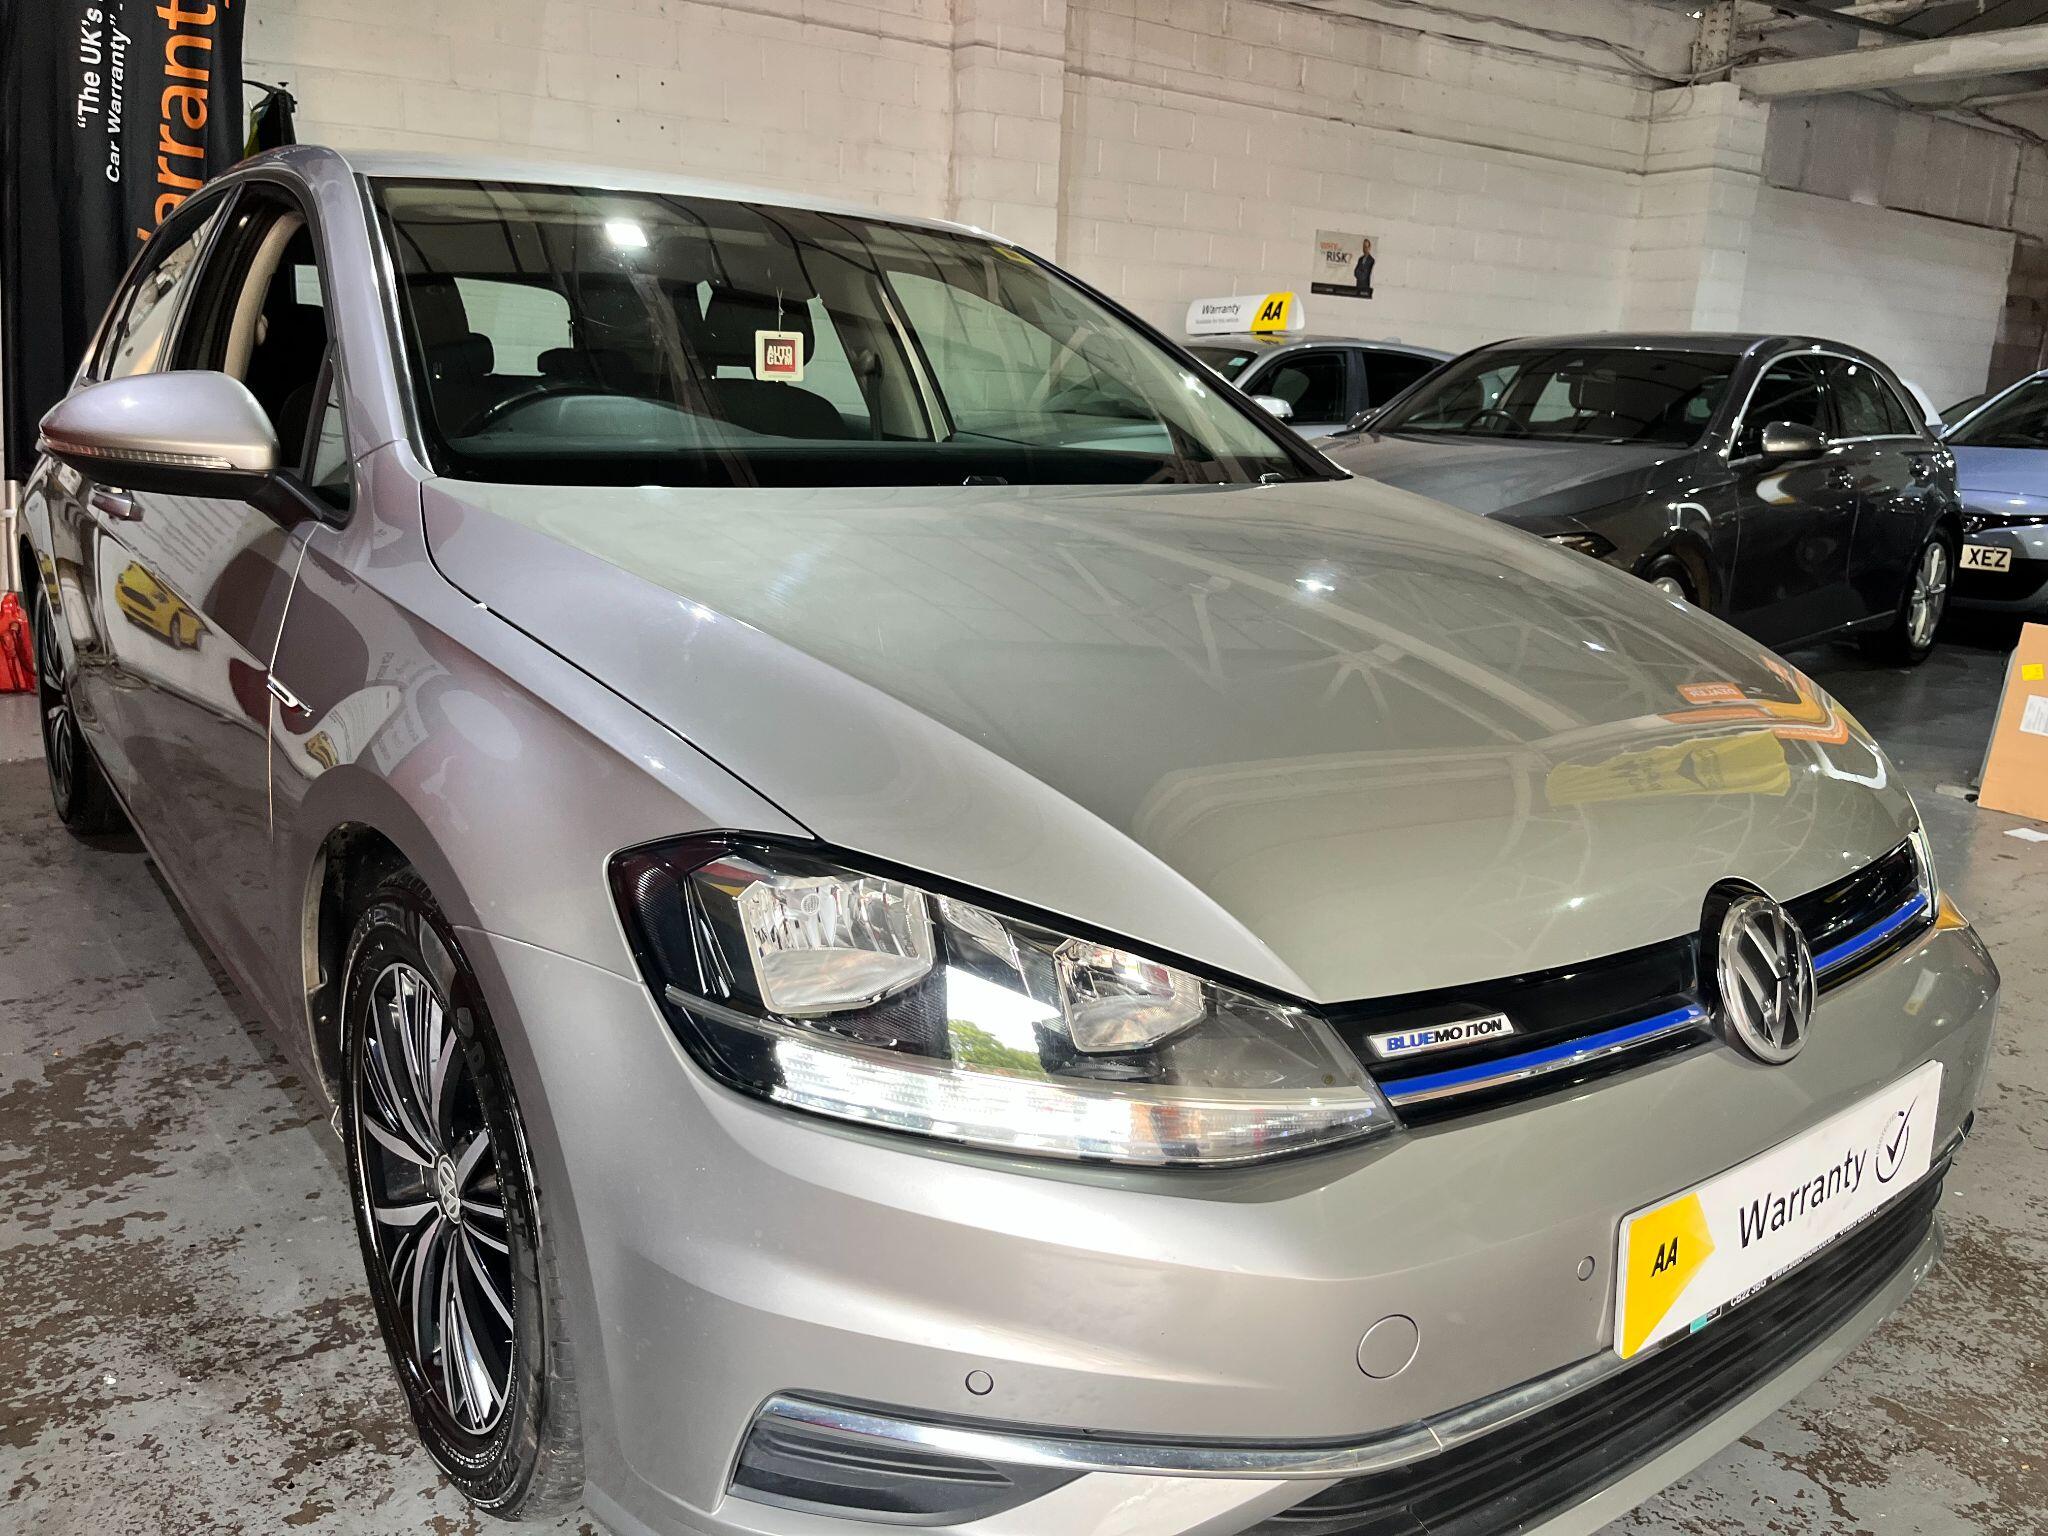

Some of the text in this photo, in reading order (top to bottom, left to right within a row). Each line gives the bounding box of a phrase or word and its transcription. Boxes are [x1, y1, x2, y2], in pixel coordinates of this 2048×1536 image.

[106, 140, 120, 183] Car
[1202, 301, 1284, 321] Warranty AA
[767, 355, 793, 366] GLYM
[768, 345, 793, 356] AUTO
[1968, 548, 2008, 568] XEZ
[1386, 1018, 1503, 1051] BLUEMOTION
[1650, 1235, 1679, 1278] AA
[1739, 1148, 1867, 1249] Warranty
